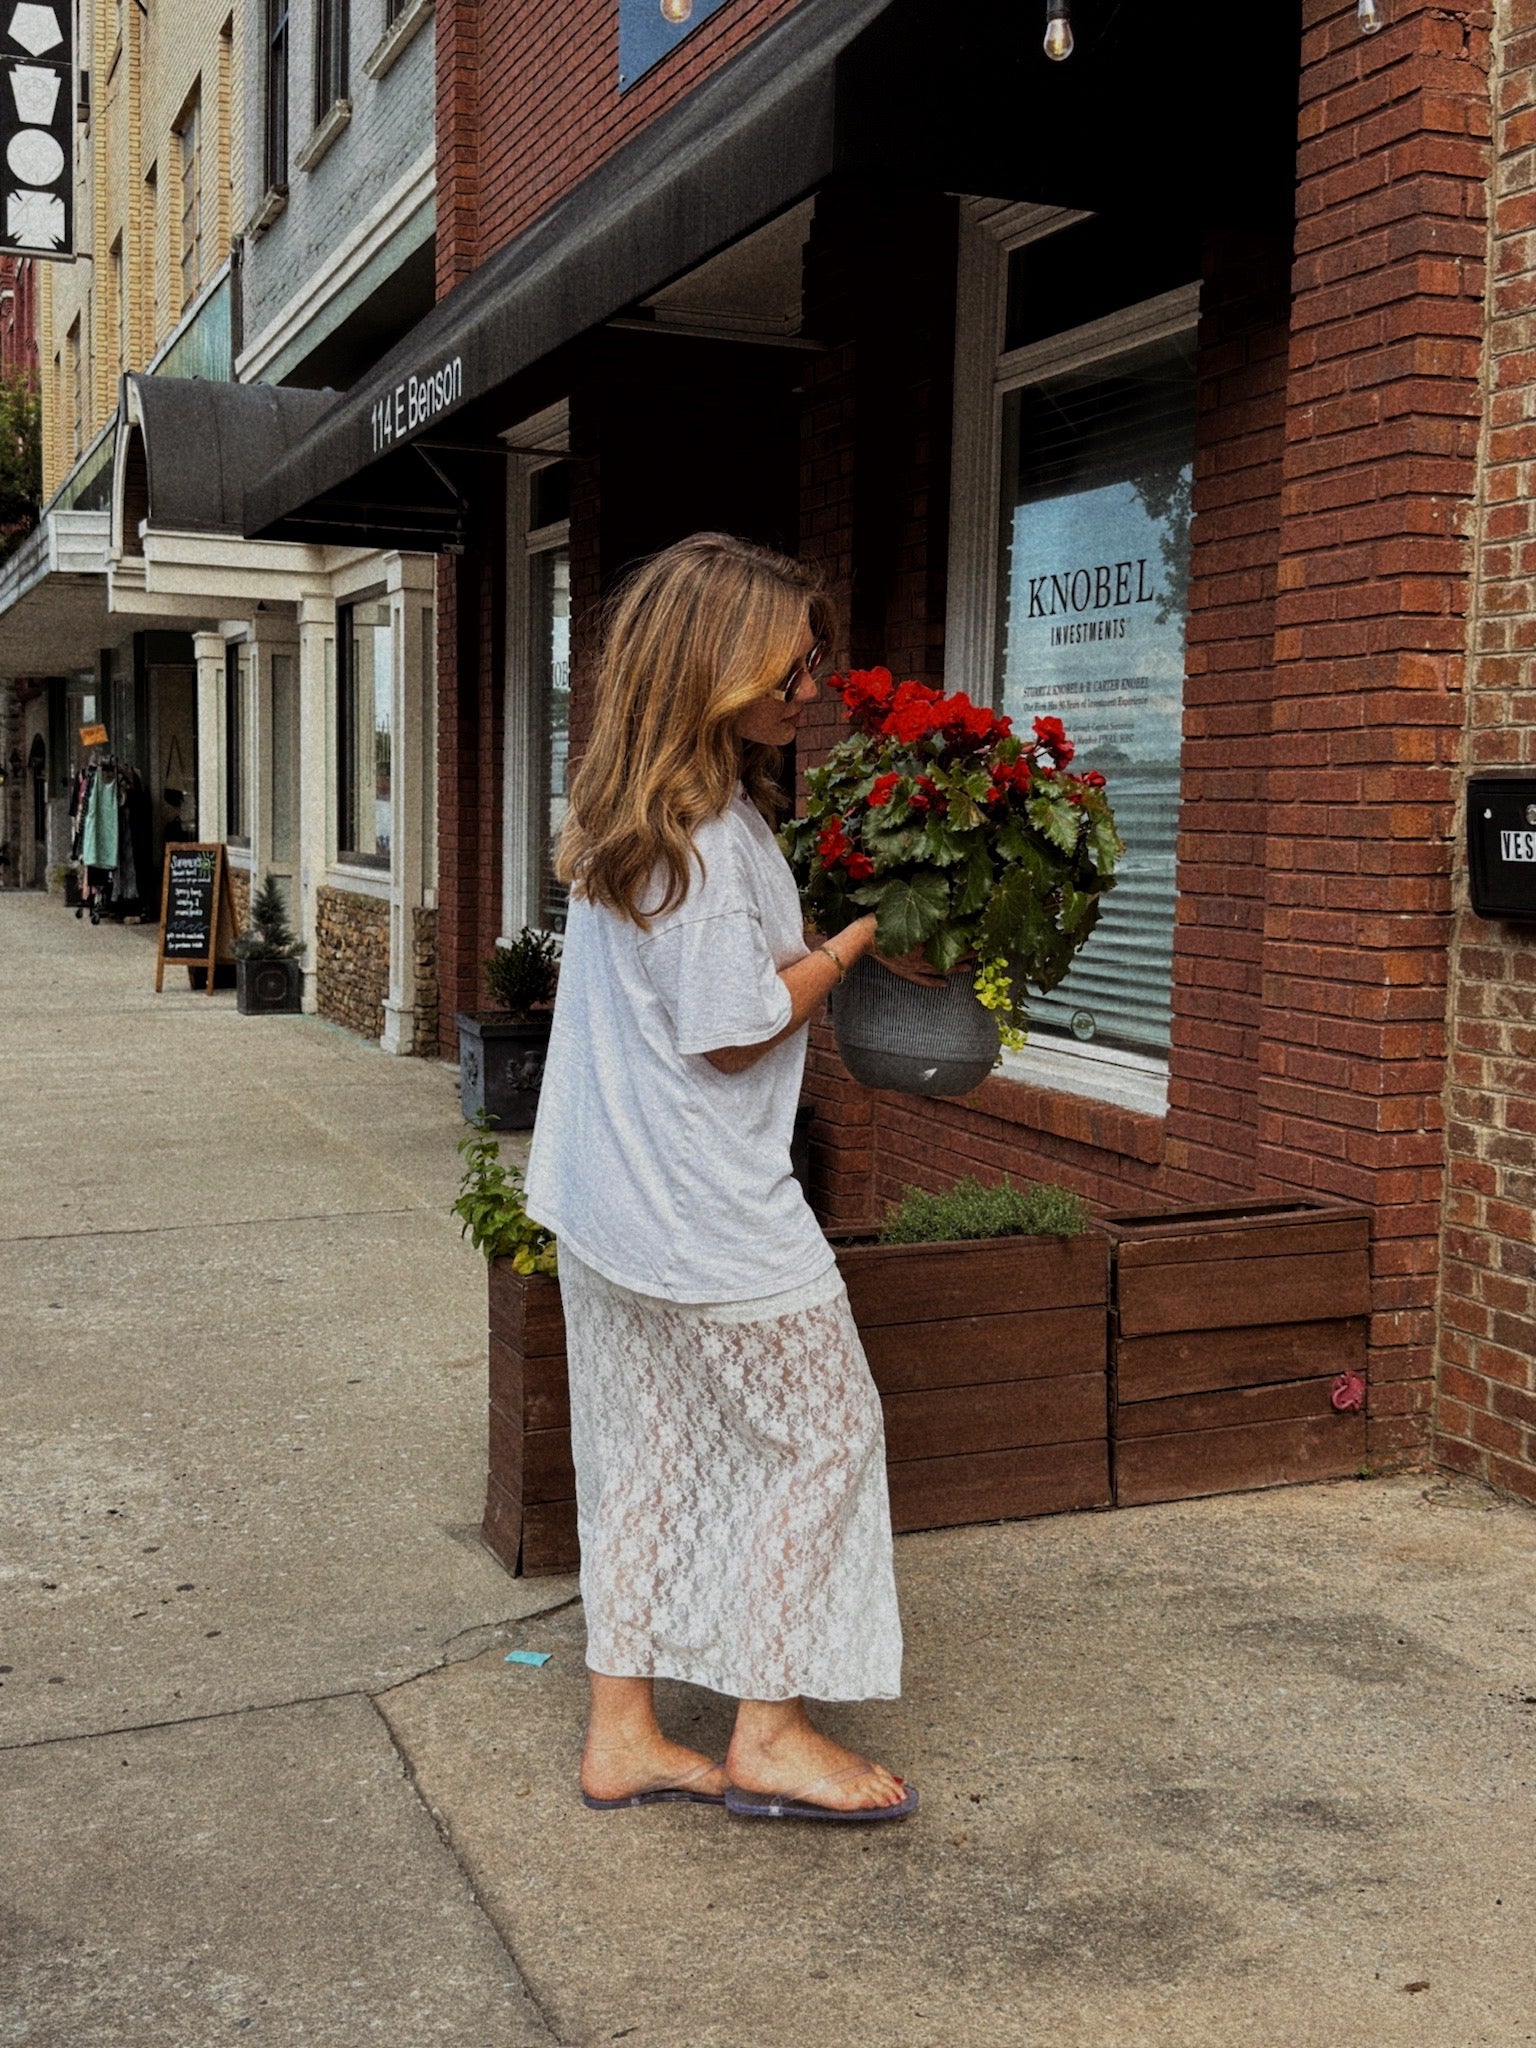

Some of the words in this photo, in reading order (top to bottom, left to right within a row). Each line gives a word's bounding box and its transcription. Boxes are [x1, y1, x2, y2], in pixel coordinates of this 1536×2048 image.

[371, 394, 393, 453] 114
[395, 383, 407, 439] E
[408, 355, 462, 431] Benson
[1028, 558, 1154, 618] KNOBEL
[1051, 618, 1126, 646] INVESTMENTS
[1502, 832, 1535, 860] VES
